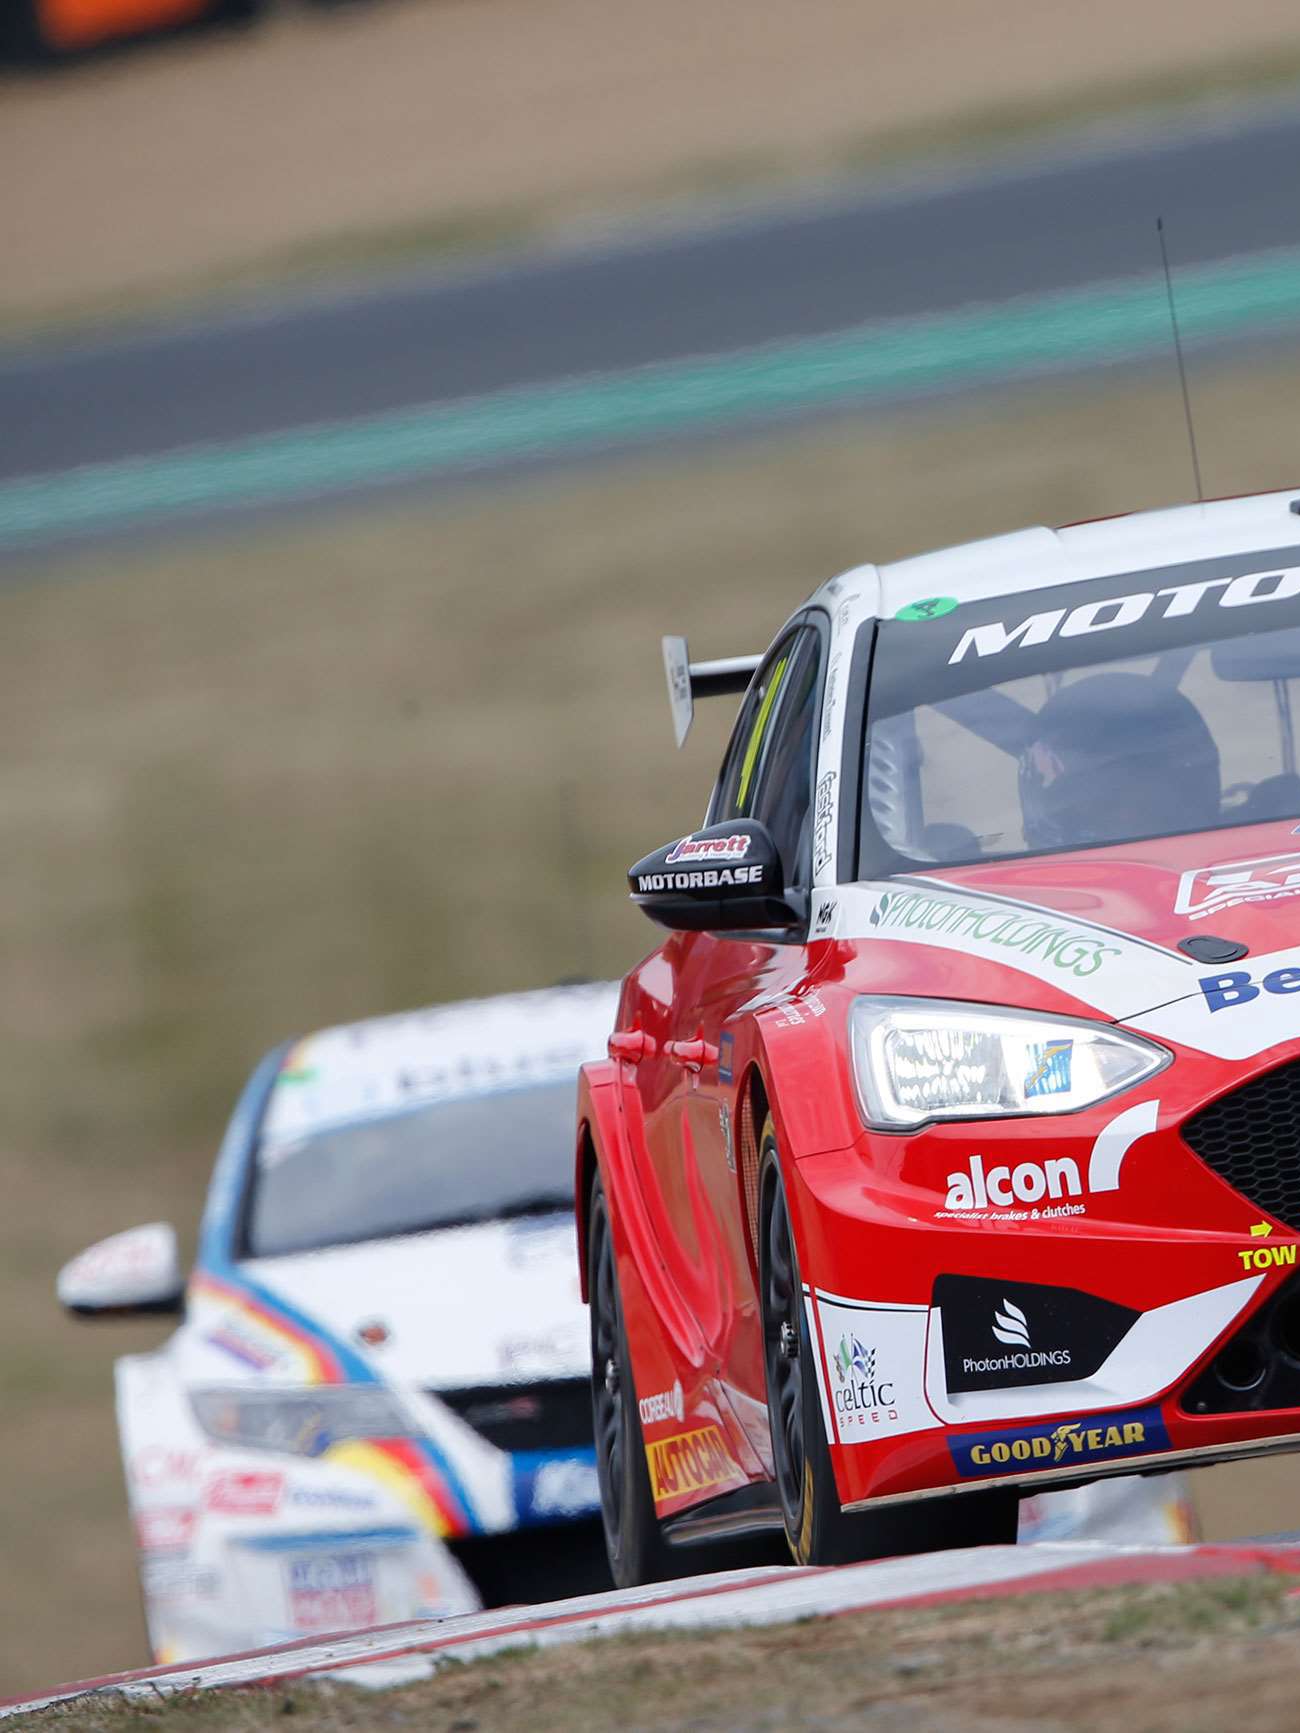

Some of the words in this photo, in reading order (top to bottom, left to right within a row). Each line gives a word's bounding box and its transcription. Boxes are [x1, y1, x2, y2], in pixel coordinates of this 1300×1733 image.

[638, 865, 764, 892] MOTORBASE
[816, 901, 838, 925] NGK
[944, 1155, 1082, 1210] alcon
[933, 1211, 989, 1221] specialist
[990, 1210, 1028, 1221] brakes
[1030, 1208, 1041, 1220] &
[1042, 1202, 1086, 1218] clutches
[1238, 1244, 1297, 1270] TOW
[963, 1350, 1071, 1373] PhotonHOLDINGS
